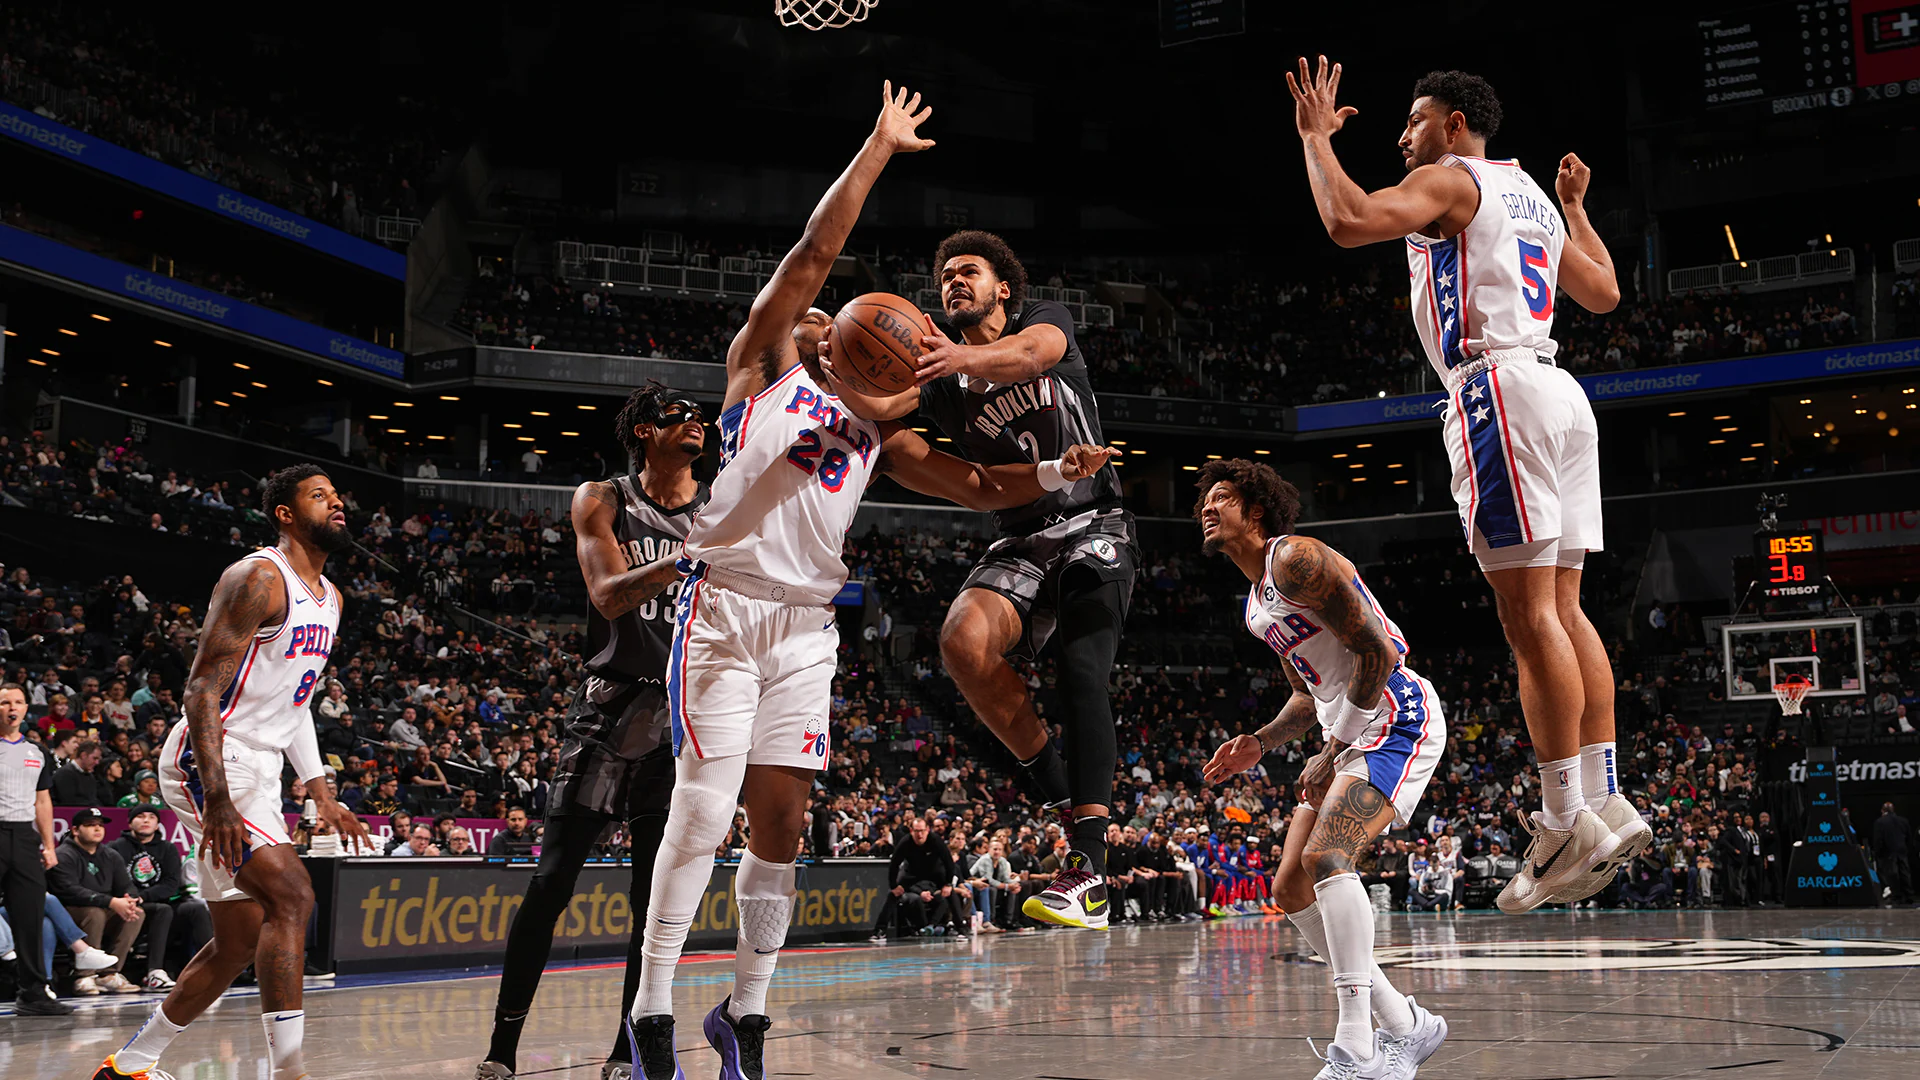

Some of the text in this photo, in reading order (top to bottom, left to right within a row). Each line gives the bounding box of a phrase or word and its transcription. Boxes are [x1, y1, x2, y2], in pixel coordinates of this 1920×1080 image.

[1715, 40, 1759, 55] Johnson
[1720, 87, 1764, 101] Johnson
[1772, 92, 1827, 114] BROOKLYN
[217, 192, 311, 240] ticketmaster
[1502, 193, 1557, 236] GRIMES
[125, 273, 230, 319] ticketmaster
[1517, 238, 1553, 321] 5
[873, 310, 924, 358] Wilso
[1594, 371, 1701, 396] ticketmaster
[785, 385, 873, 470] PHILA
[786, 428, 850, 494] 28
[1769, 536, 1814, 554] 10:55
[1767, 553, 1805, 583] 3.8
[1779, 585, 1820, 597] TISSOT
[285, 623, 335, 660] PHIL
[1292, 652, 1322, 686] 9
[293, 669, 317, 706] 8
[1808, 834, 1845, 843] BARCLAYS
[1797, 875, 1863, 888] BARCLAYS
